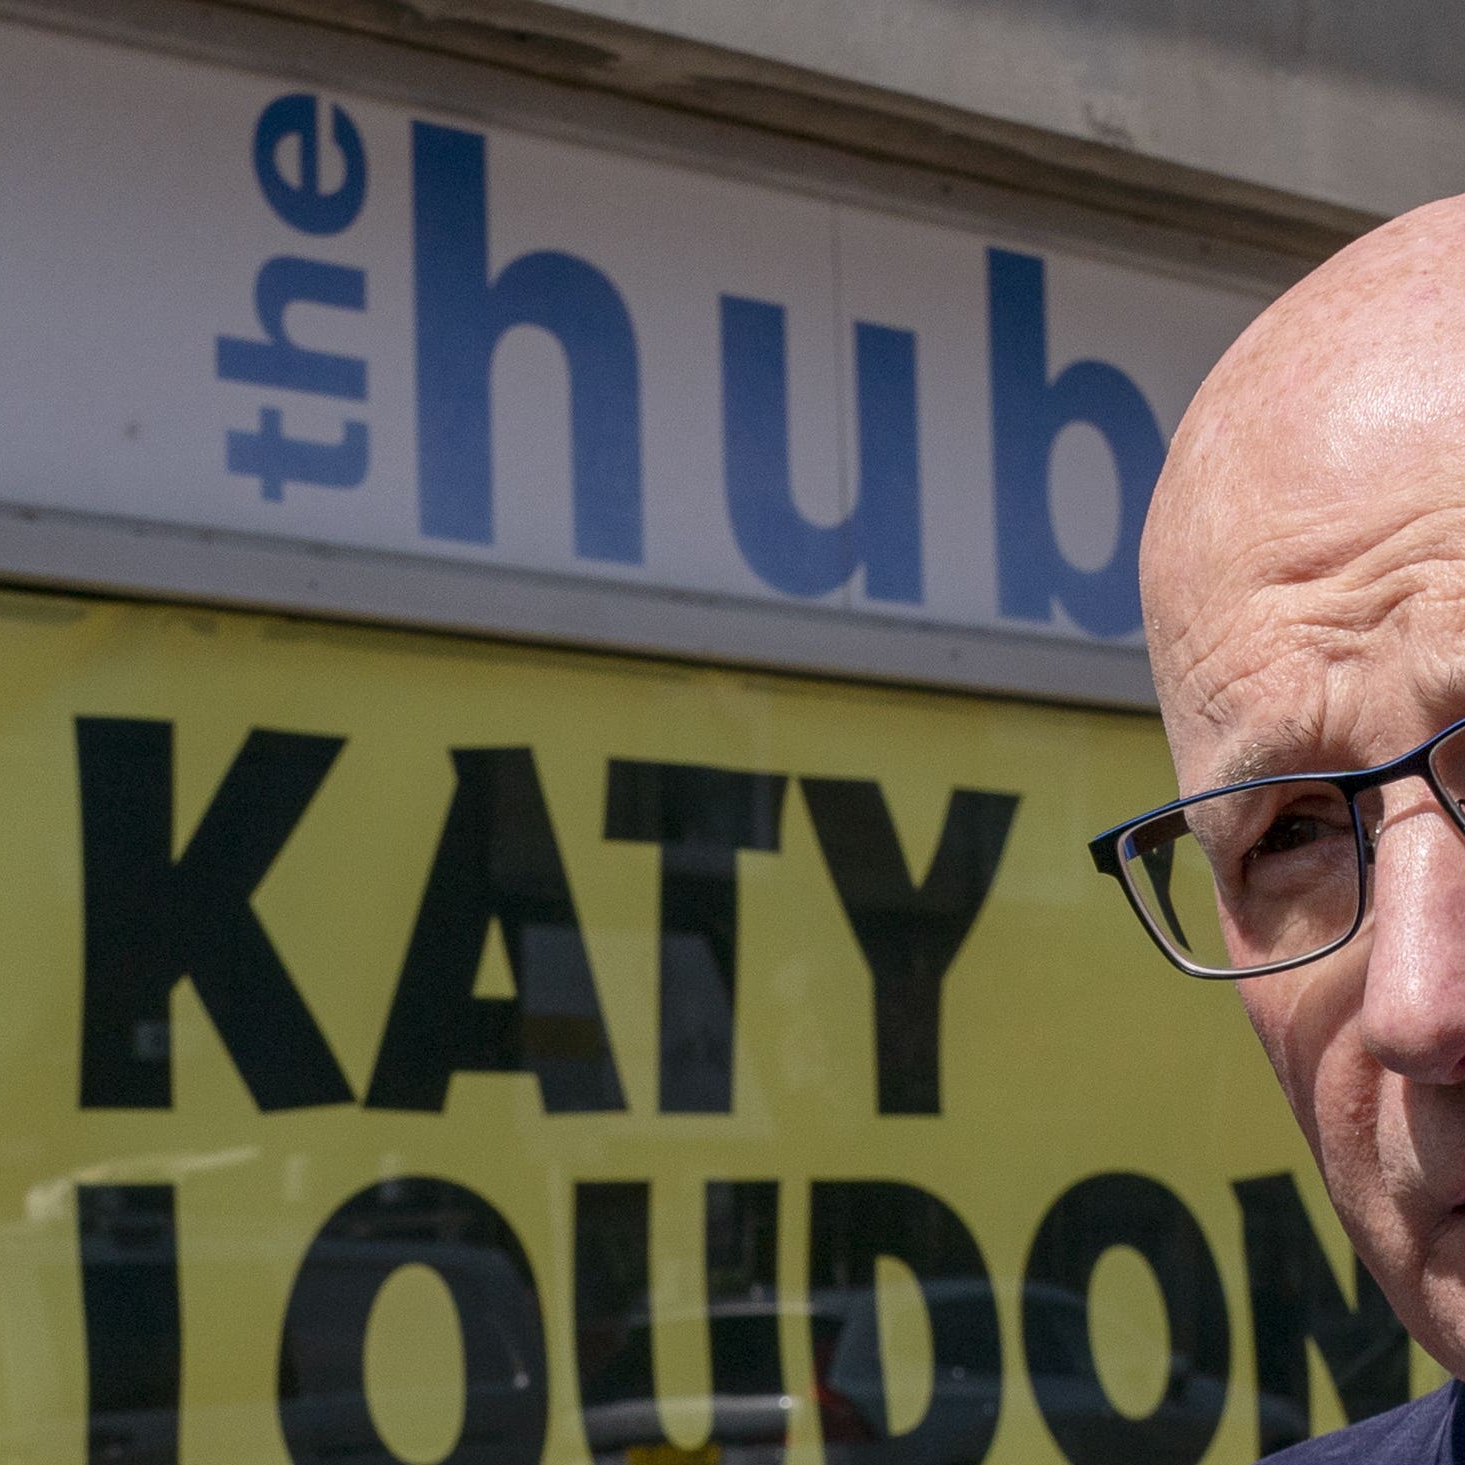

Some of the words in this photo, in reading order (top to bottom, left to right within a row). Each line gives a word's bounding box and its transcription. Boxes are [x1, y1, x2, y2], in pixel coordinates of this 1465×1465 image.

[216, 92, 369, 503] the
[410, 118, 1169, 640] hub
[73, 714, 1026, 1117] KATY
